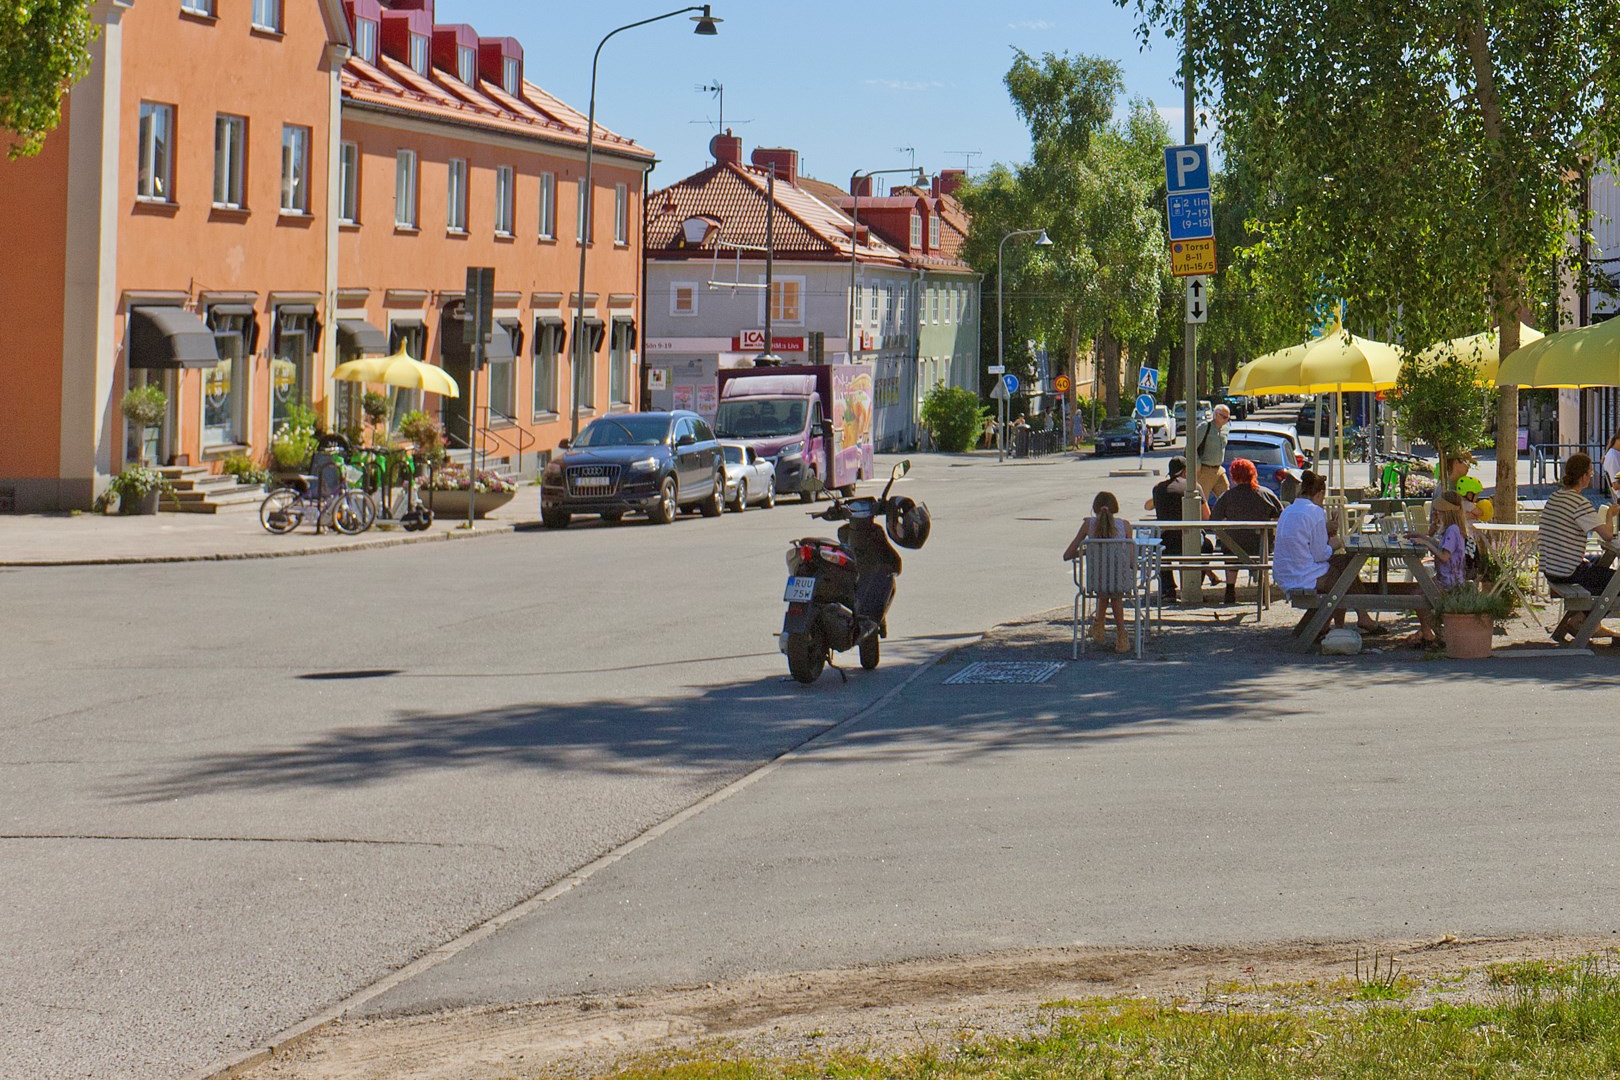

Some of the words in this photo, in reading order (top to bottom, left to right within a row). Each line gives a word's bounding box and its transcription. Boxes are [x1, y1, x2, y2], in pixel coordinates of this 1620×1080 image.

[1176, 151, 1200, 187] P
[1183, 199, 1189, 207] 2
[1193, 198, 1209, 206] tim
[1186, 209, 1208, 219] 7-19
[1182, 218, 1211, 229] (9-15)
[1185, 243, 1210, 251] Torsd
[1185, 253, 1202, 261] 8-11
[1175, 262, 1214, 272] 1/11-15/5
[744, 331, 765, 343] ICA
[1057, 380, 1068, 388] 40
[795, 579, 813, 588] RUU
